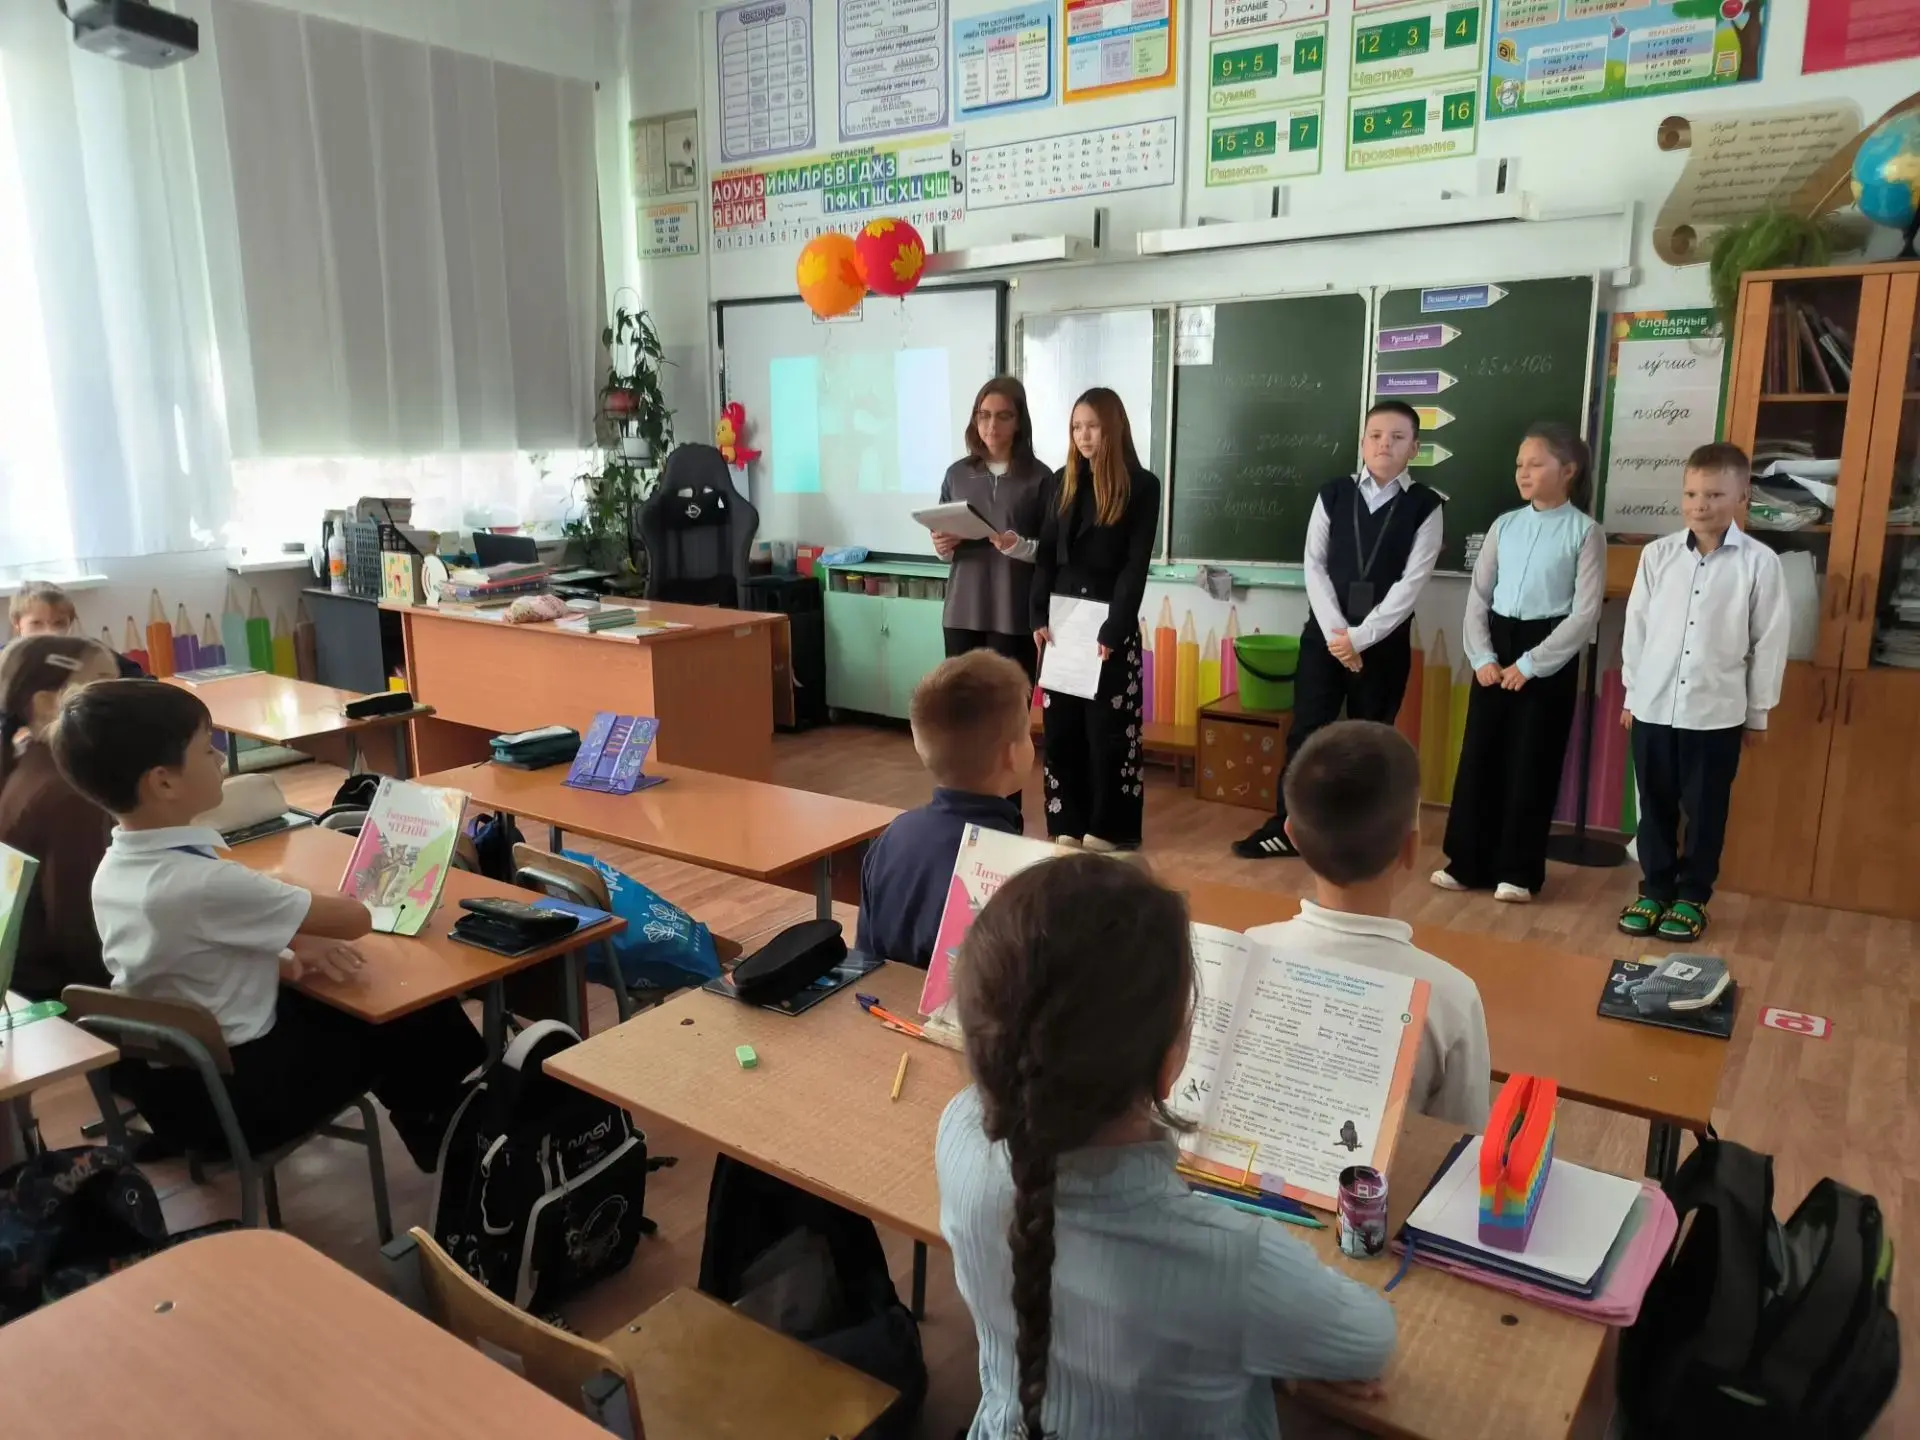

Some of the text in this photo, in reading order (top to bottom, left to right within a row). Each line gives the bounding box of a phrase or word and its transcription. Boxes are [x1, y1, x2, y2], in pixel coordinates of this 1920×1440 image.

[1360, 35, 1380, 54] 12
[1407, 26, 1418, 46] 3
[1455, 17, 1467, 37] 4
[1222, 60, 1232, 76] 9
[1253, 54, 1264, 72] 5
[1299, 46, 1318, 65] 14
[1363, 116, 1374, 133] 8
[1401, 109, 1413, 128] 2
[1448, 102, 1470, 120] 16
[1217, 136, 1236, 152] 15
[1255, 131, 1264, 147] 8
[1299, 123, 1309, 142] 7
[831, 146, 875, 161] СОГЛАСНЫЕ
[912, 214, 921, 225] 17
[925, 211, 935, 223] 18
[938, 209, 949, 222] 19
[951, 207, 963, 221] 20
[1639, 317, 1707, 328] СЛОВАРНЫЕ
[1653, 327, 1690, 336] СЛОВА
[408, 864, 440, 907] 4
